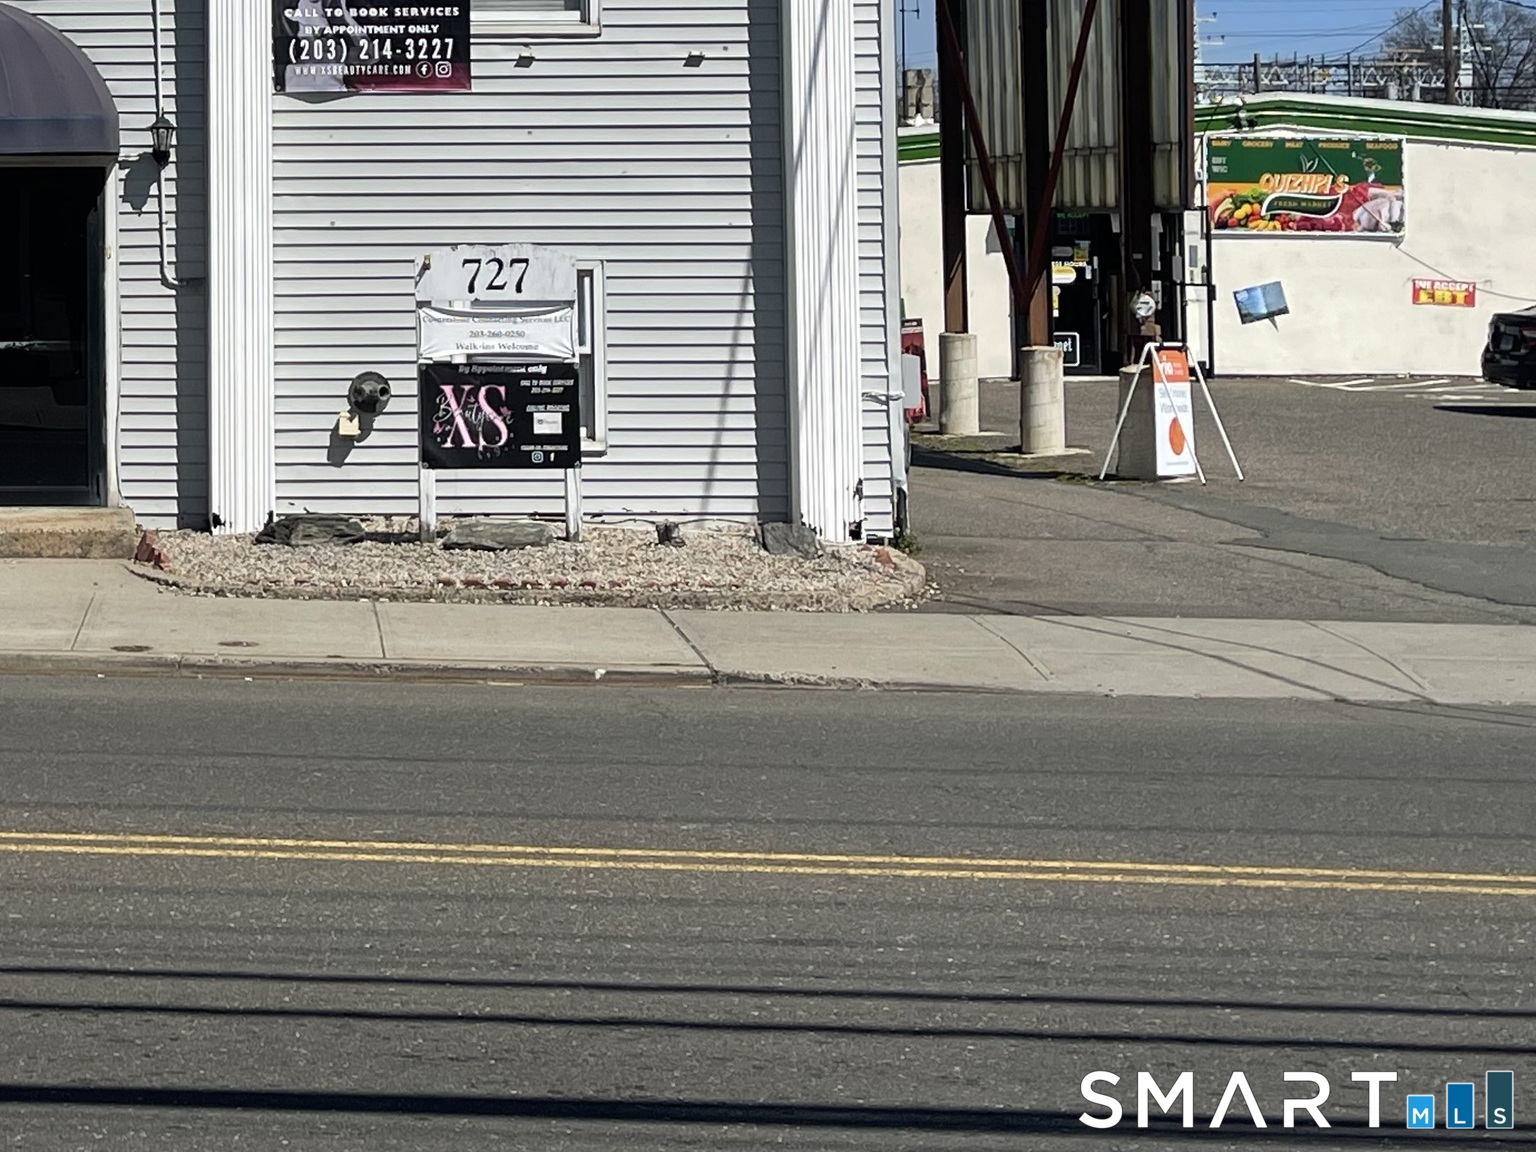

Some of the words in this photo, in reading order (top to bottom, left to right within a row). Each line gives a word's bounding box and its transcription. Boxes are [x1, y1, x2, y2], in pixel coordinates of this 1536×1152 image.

[284, 8, 319, 17] CALL
[325, 7, 344, 17] TO
[350, 7, 389, 17] BOOK
[394, 6, 460, 16] SERVICES
[305, 25, 320, 35] BY
[323, 24, 405, 34] APPOINTMENT
[408, 24, 440, 34] ONLY
[289, 38, 348, 63] (203)
[359, 38, 454, 61] 214-3227
[462, 257, 530, 294] 727
[1415, 280, 1432, 289] WE
[1433, 281, 1474, 293] ACCEPT
[1416, 289, 1470, 306] EBT
[440, 384, 508, 448] XS
